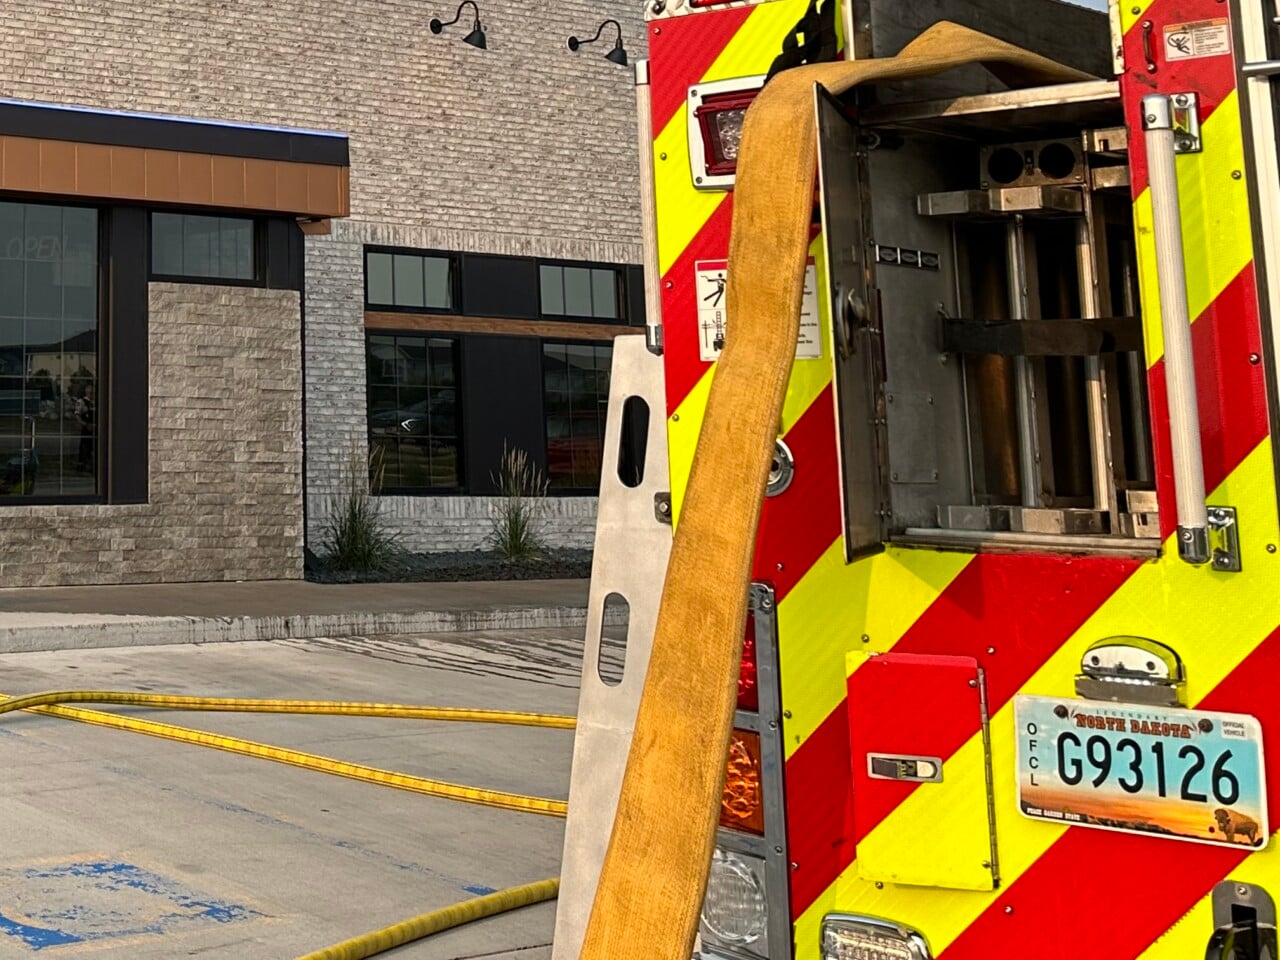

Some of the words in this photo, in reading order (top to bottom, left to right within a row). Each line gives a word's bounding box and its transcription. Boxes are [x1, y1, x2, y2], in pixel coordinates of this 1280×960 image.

[1075, 713, 1126, 733] NORTH
[1130, 719, 1192, 738] DAKOTA
[1057, 731, 1239, 806] G93126
